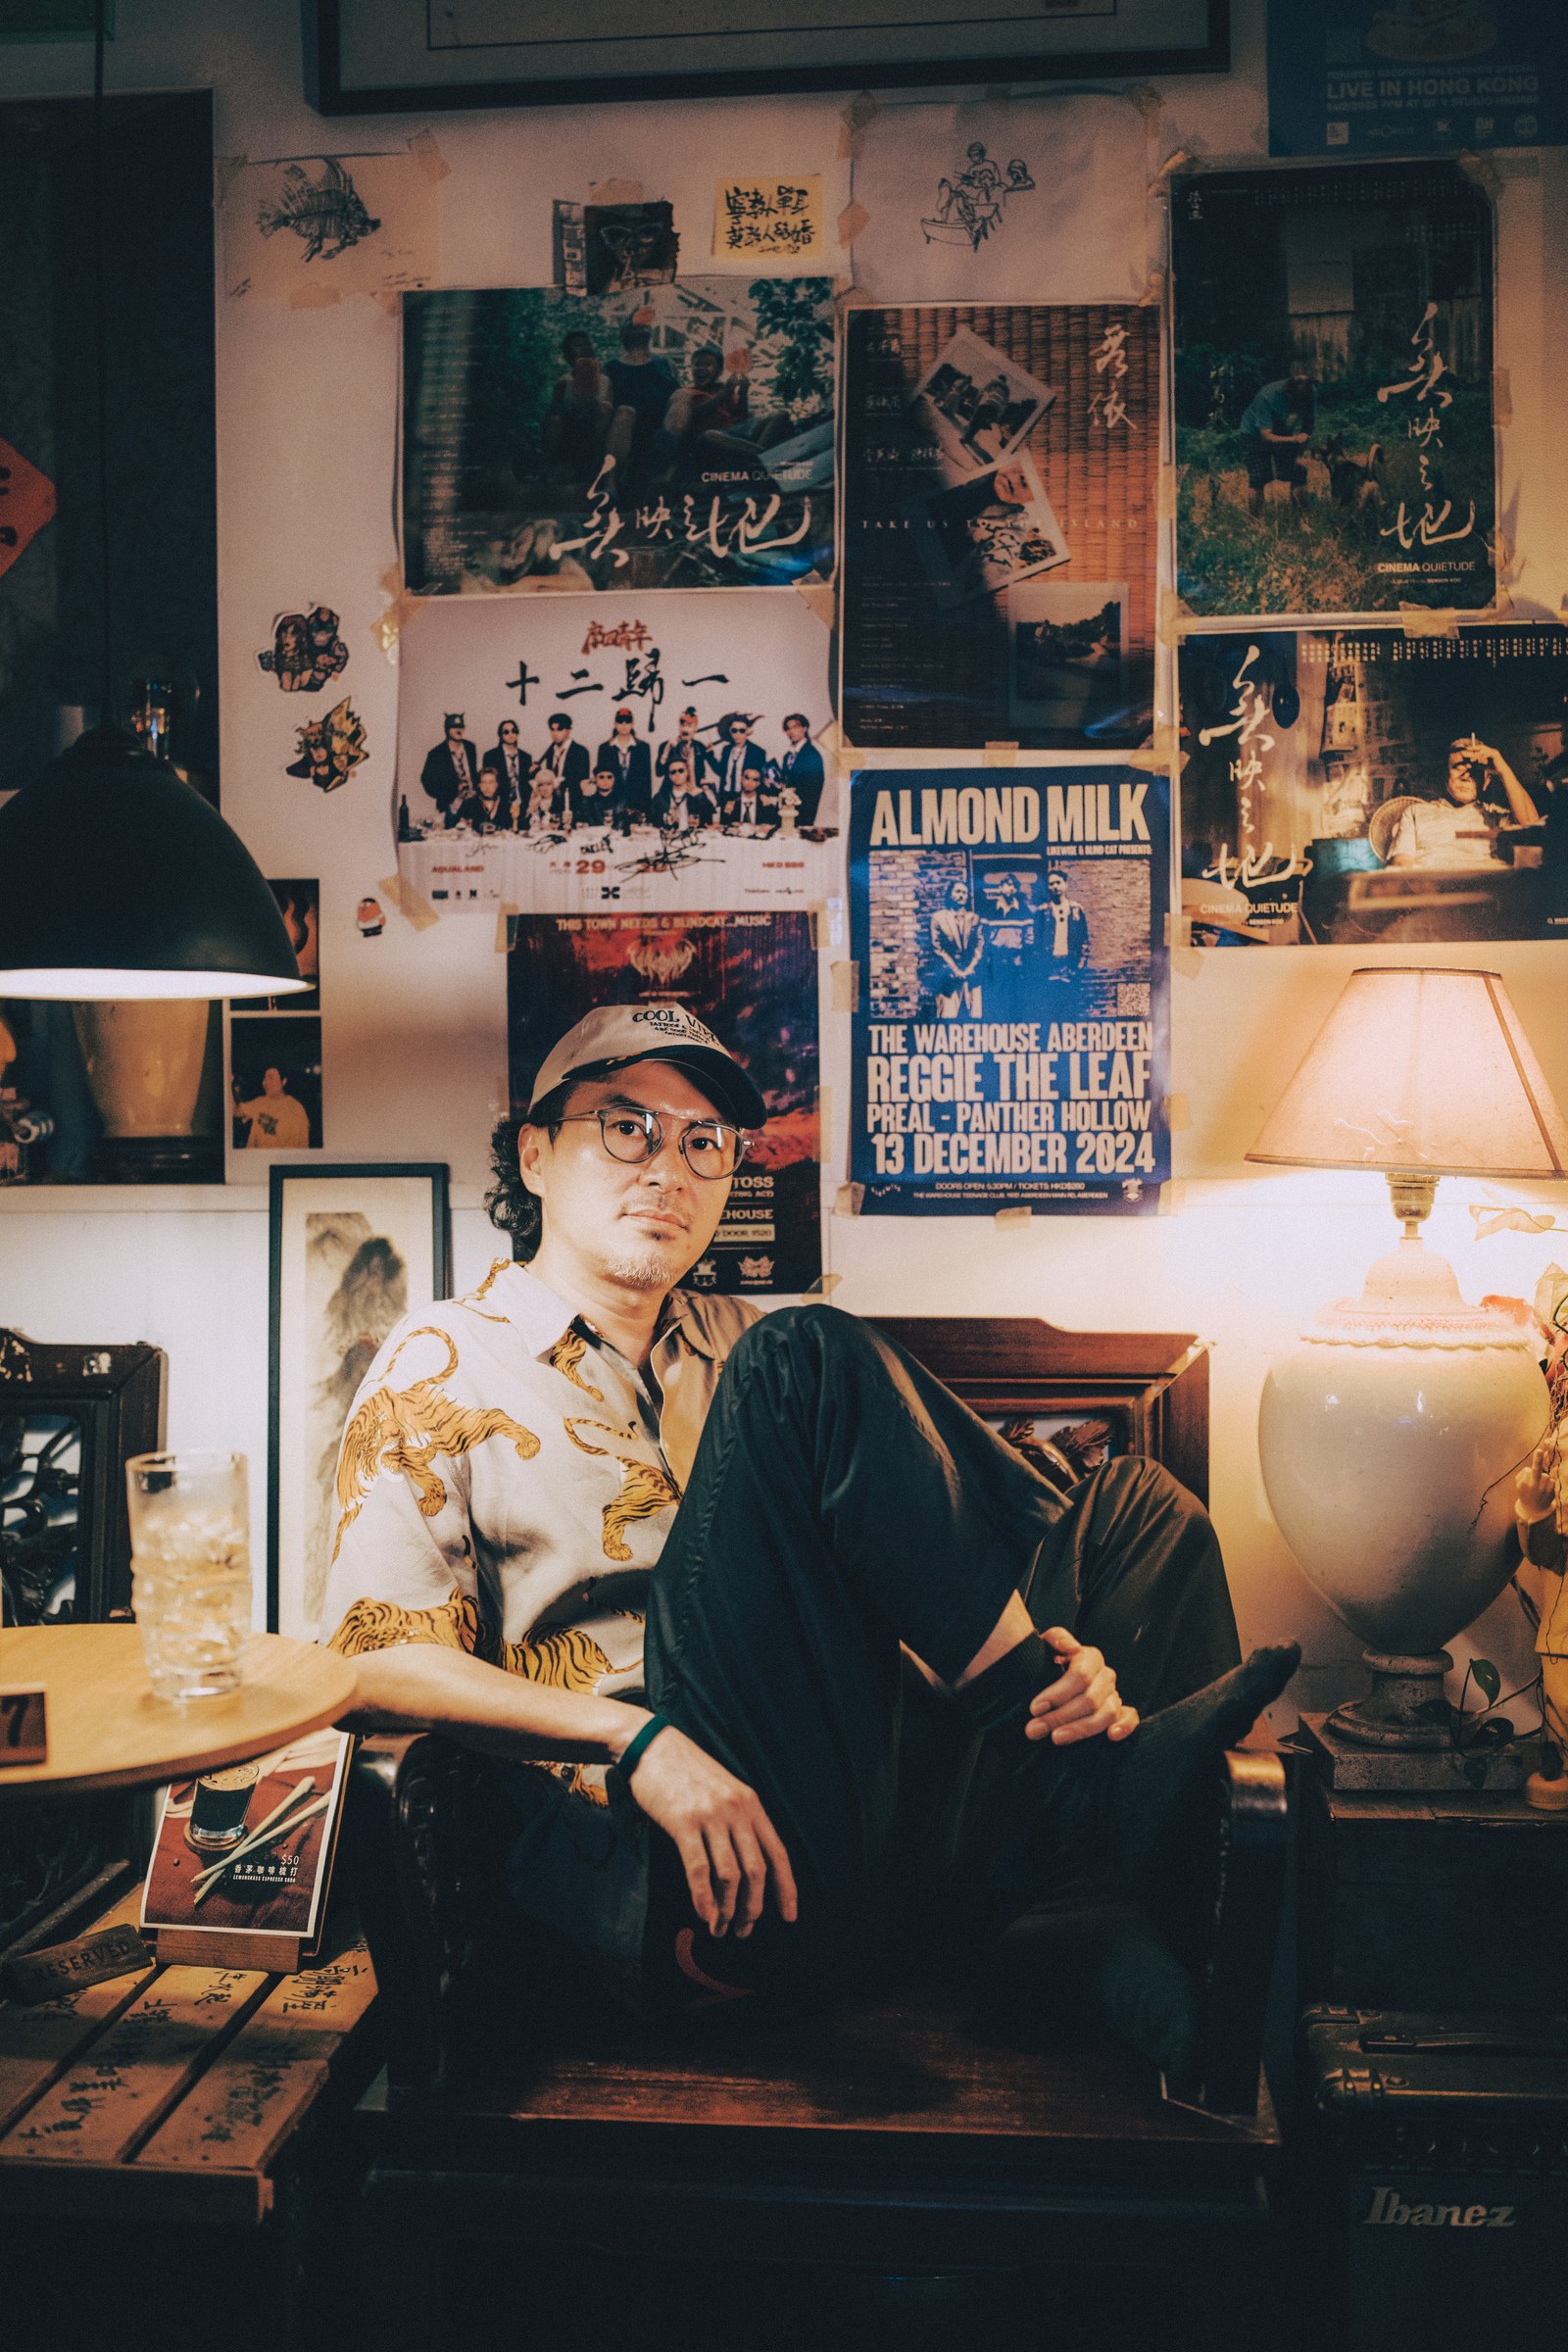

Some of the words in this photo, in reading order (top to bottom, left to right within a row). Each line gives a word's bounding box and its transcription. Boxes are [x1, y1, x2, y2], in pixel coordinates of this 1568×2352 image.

[1327, 81, 1374, 99] LIVE
[1380, 79, 1401, 96] IN
[1407, 78, 1471, 96] HONG
[1476, 75, 1540, 93] KONG
[701, 471, 750, 483] CINEMA
[861, 519, 910, 530] TAKE
[926, 519, 949, 530] US
[1377, 562, 1421, 573] CINEMA
[1422, 561, 1476, 572] QUIETUDE
[506, 647, 729, 733] 十二歸一
[869, 787, 1041, 846] ALMOND
[1047, 784, 1151, 842] MILK
[431, 864, 485, 874] AQUALAND
[574, 858, 606, 875] 29
[1200, 903, 1242, 914] CINEMA
[1244, 902, 1298, 914] QUIETUDE
[556, 918, 582, 931] THIS
[584, 917, 616, 930] TOWN
[619, 916, 659, 929] NEEDS
[632, 1009, 680, 1023] COOL
[868, 1025, 907, 1054] THE
[913, 1023, 1042, 1054] WAREHOUSE
[1047, 1022, 1153, 1052] ABERDEEN
[867, 1054, 984, 1103] REGGIE
[994, 1053, 1059, 1102] THE
[1069, 1052, 1152, 1101] LEAF
[867, 1102, 935, 1133] PREAL
[956, 1102, 1054, 1132] PANTHER
[1060, 1101, 1152, 1131] HOLLOW
[870, 1134, 905, 1175] 13
[913, 1133, 1067, 1174] DECEMBER
[1076, 1132, 1155, 1174] 2024
[936, 1182, 961, 1191] DOORS
[2, 1694, 29, 1748] 7
[281, 1854, 300, 1866] $50
[35, 1938, 130, 1981] RESERVED
[1362, 2186, 1517, 2228] Ibanez
